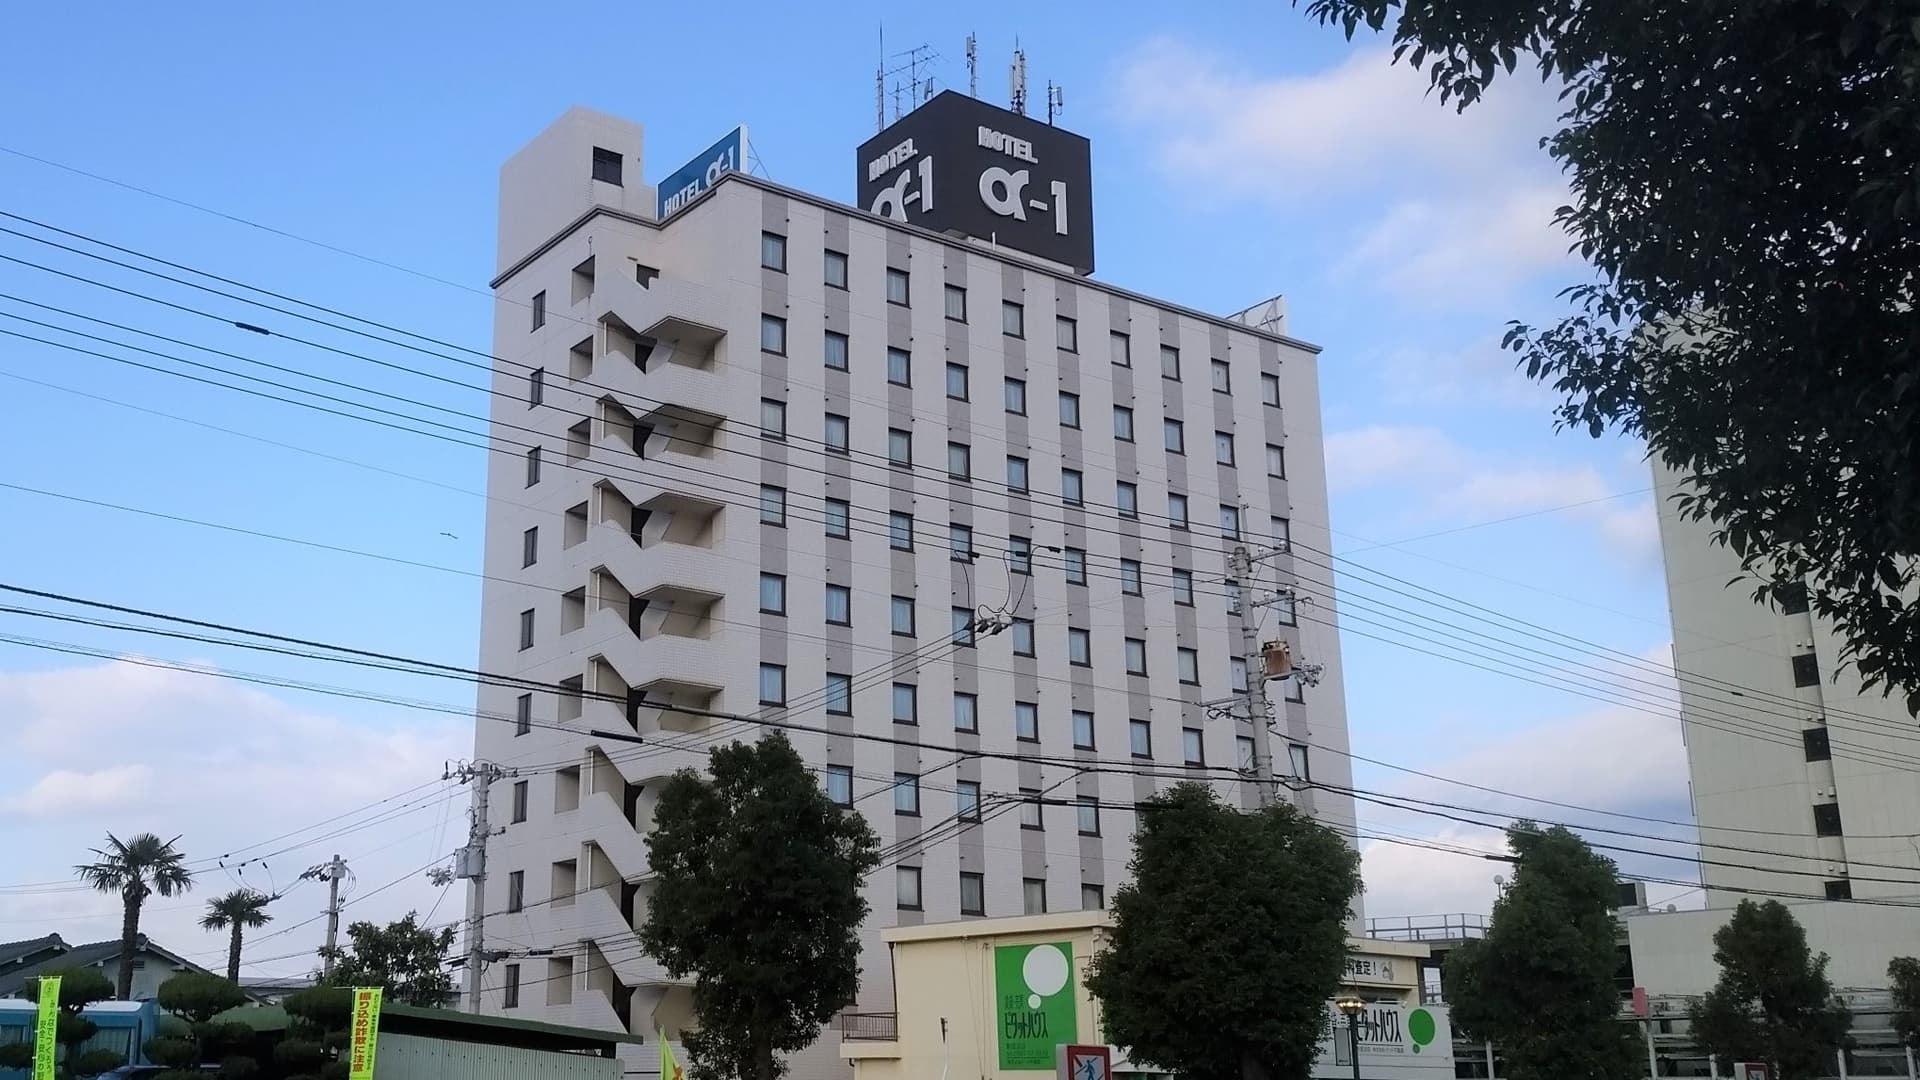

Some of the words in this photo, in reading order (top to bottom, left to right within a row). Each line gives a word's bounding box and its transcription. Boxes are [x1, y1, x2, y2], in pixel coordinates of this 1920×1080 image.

[868, 137, 918, 182] HOTEL
[978, 126, 1039, 164] HOTEL
[663, 178, 703, 217] HOTEL
[353, 992, 371, 1072] 振り込め詐欺に注意
[1005, 1011, 1048, 1039] ピタットハウス
